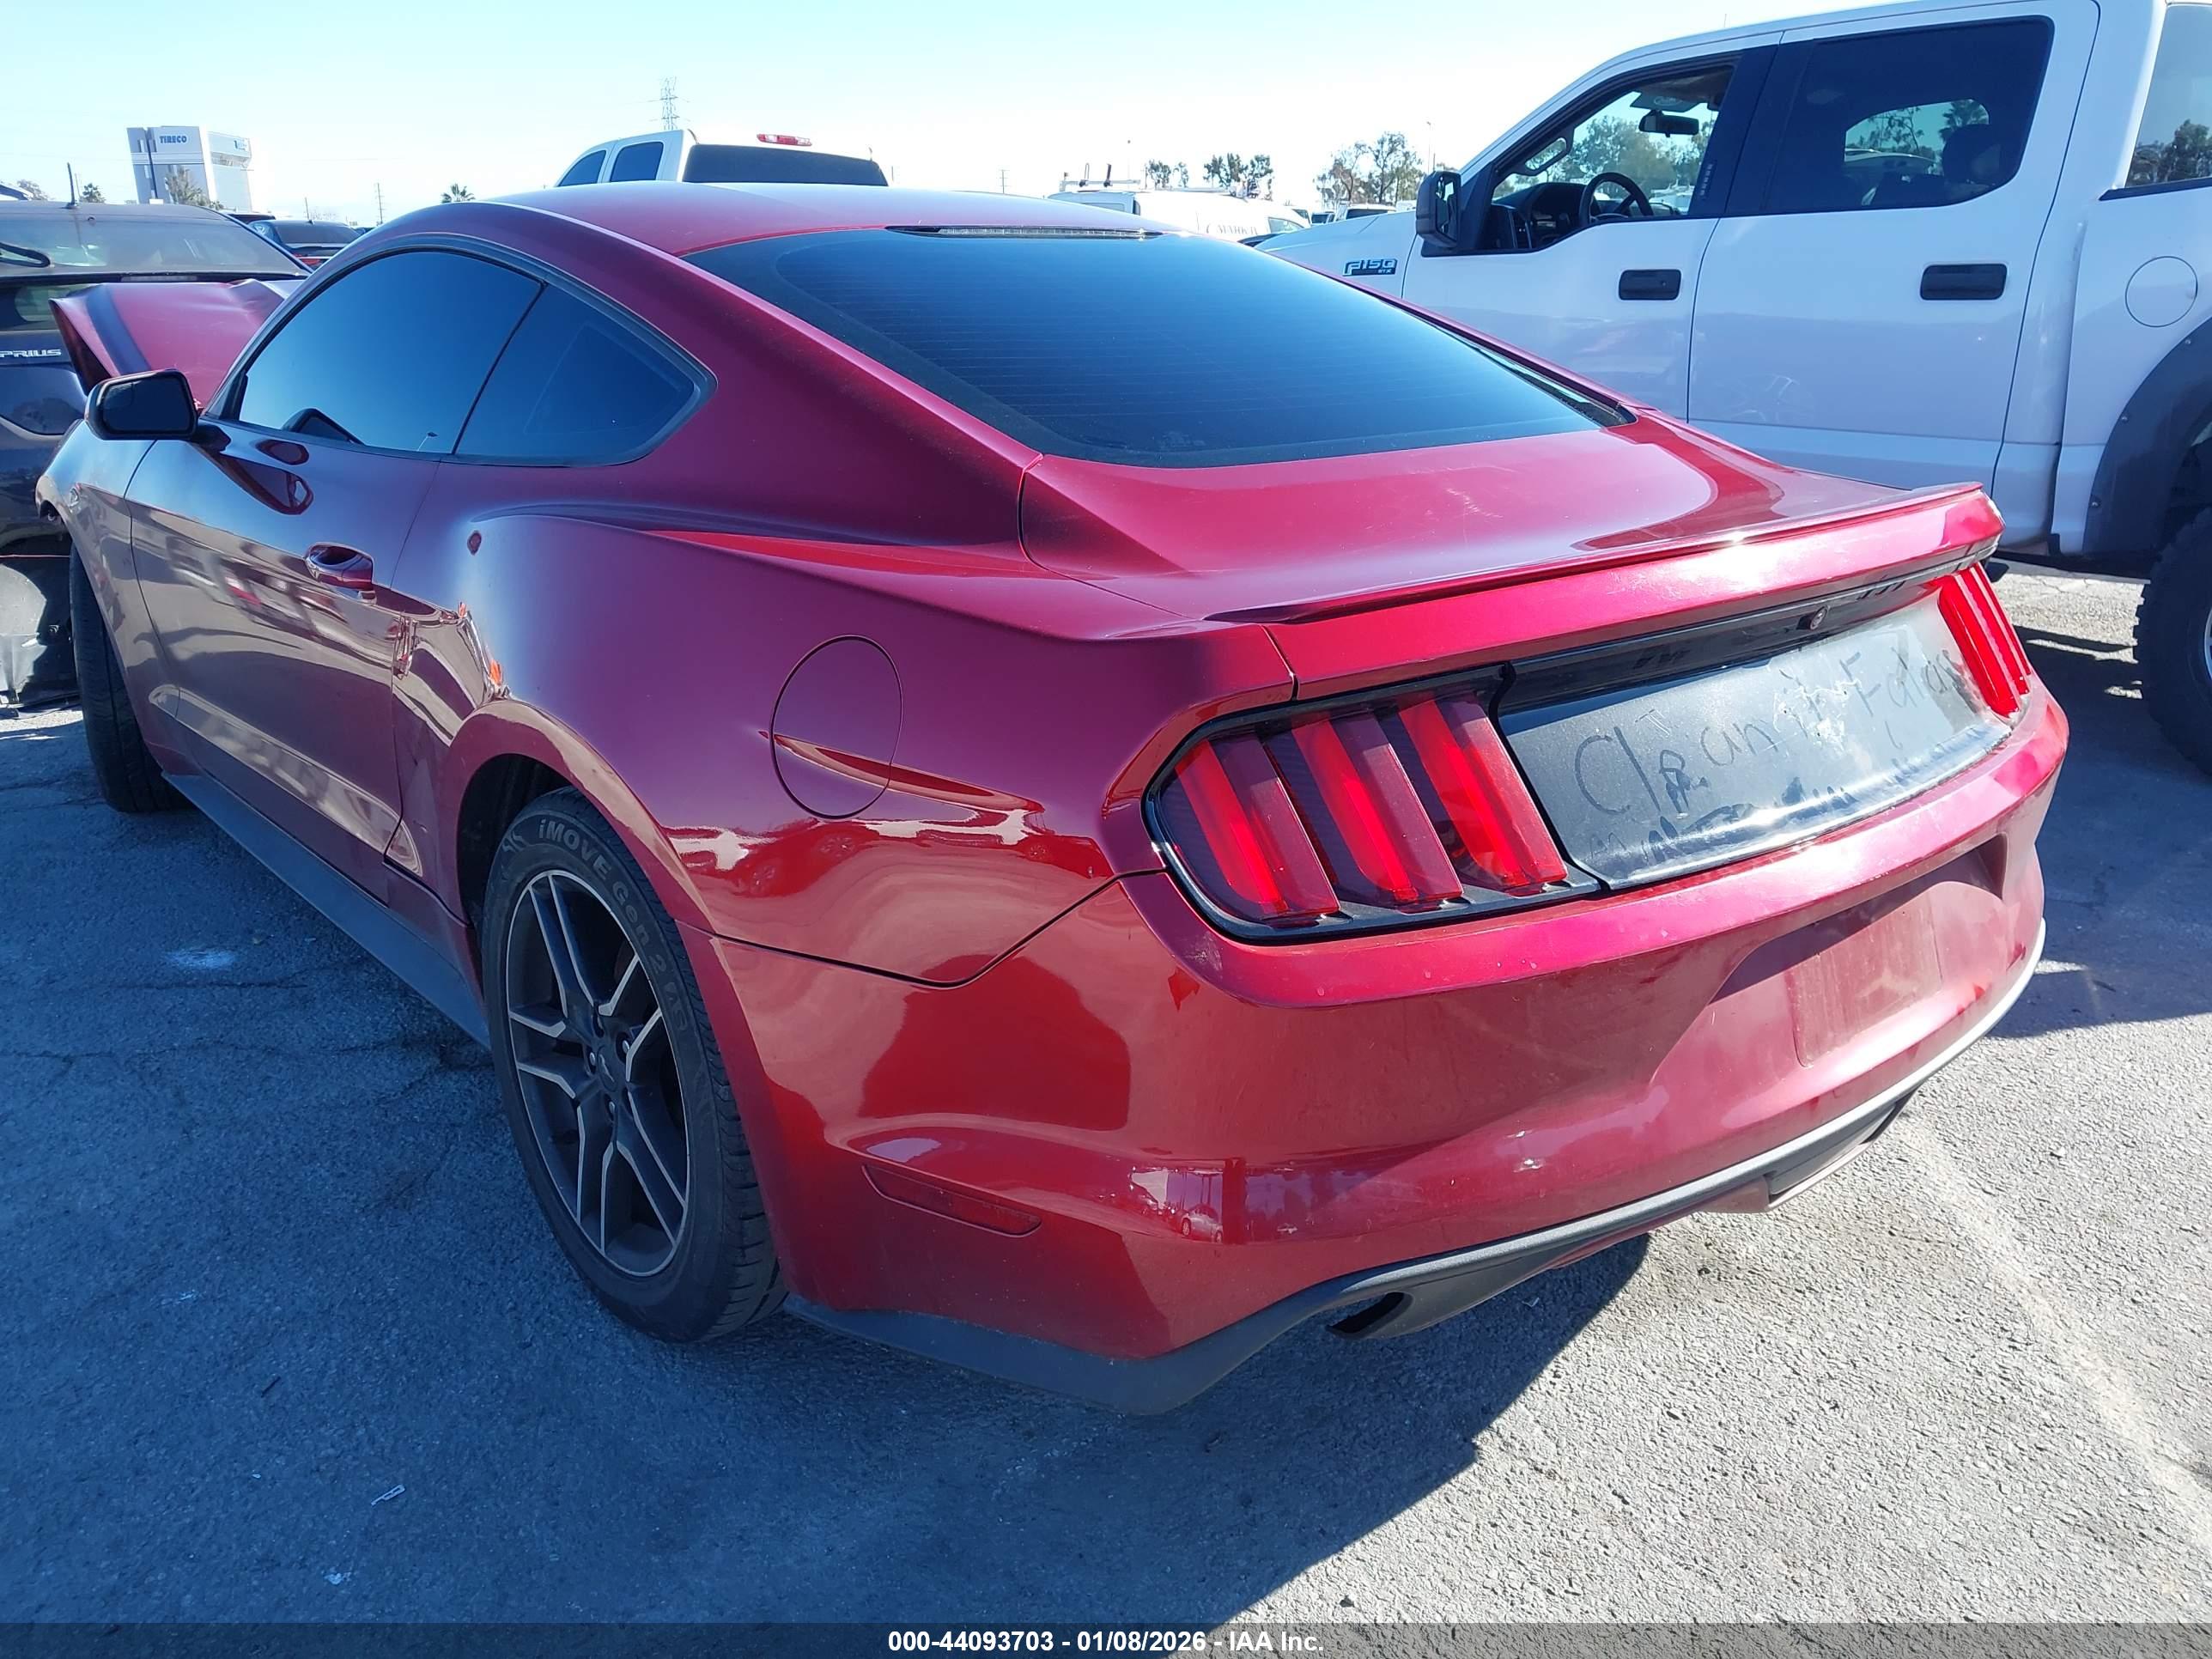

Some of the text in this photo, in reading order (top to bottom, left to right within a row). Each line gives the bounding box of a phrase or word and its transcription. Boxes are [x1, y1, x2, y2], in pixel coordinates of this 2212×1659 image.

[1343, 258, 1398, 276] F150
[0, 349, 62, 358] PRIUS
[538, 818, 611, 880] iMOVE
[611, 881, 649, 945] Gen
[647, 954, 668, 974] 2
